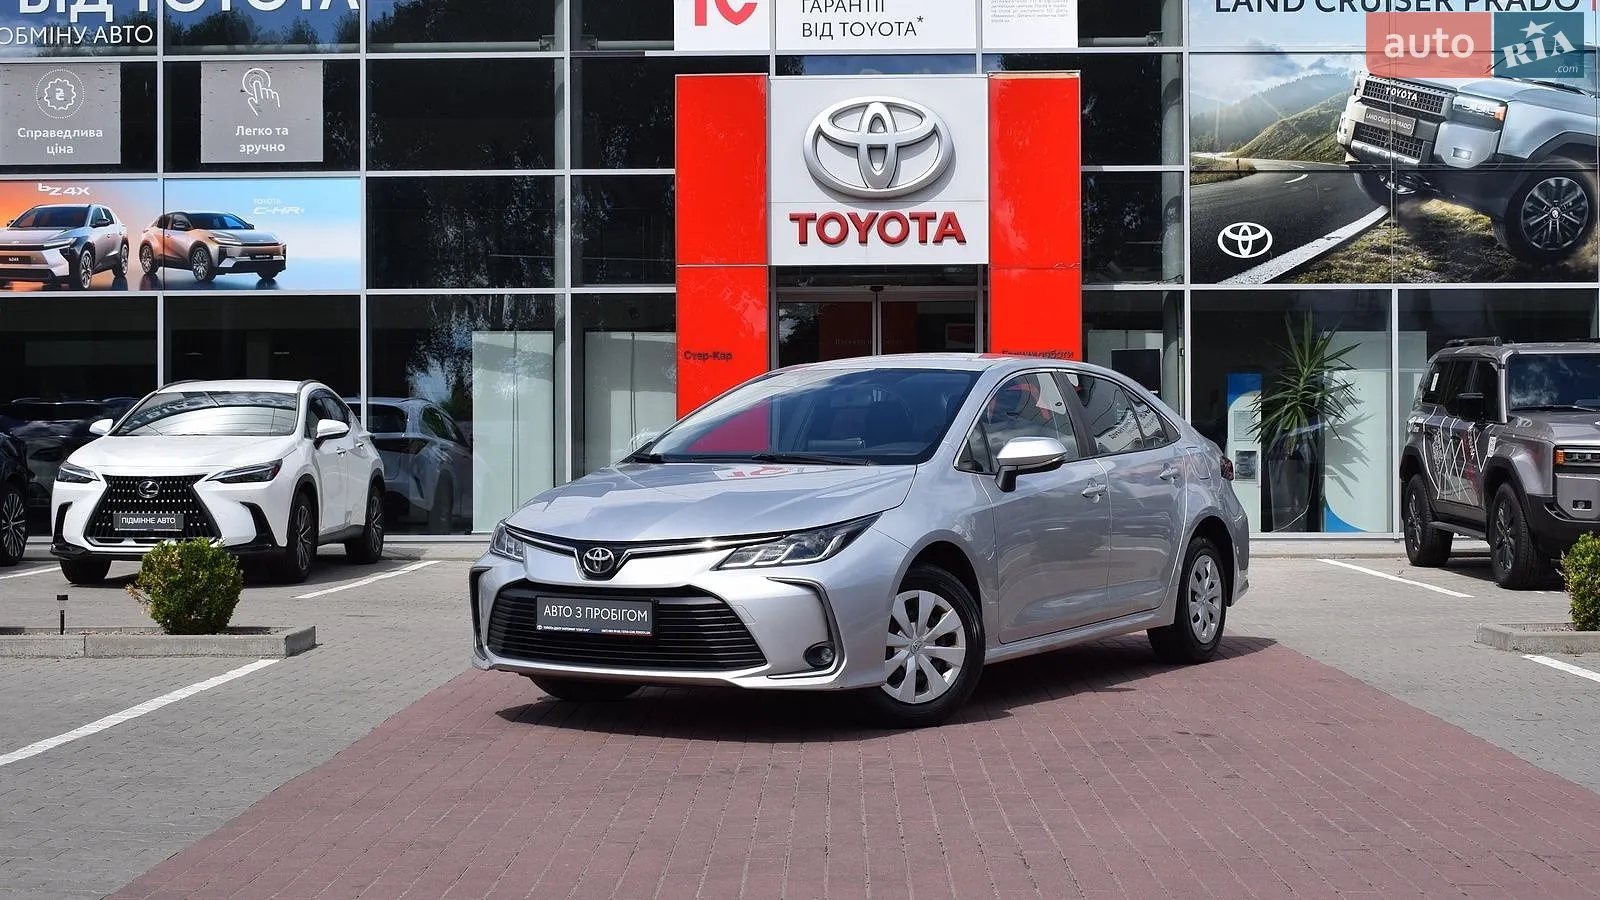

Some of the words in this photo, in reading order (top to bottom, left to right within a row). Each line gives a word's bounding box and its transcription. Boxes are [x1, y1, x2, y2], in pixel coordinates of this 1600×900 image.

[93, 25, 154, 44] АВТО
[802, 22, 834, 41] ВІД
[1386, 87, 1418, 101] TOYOTA
[17, 127, 103, 141] Справедлива
[235, 125, 271, 137] Легко
[273, 126, 289, 136] та
[46, 142, 74, 155] ціна
[239, 142, 286, 154] зручно
[38, 183, 90, 196] bZ4X
[789, 211, 967, 246] TOYOTA
[121, 517, 156, 525] ПІДМІННЕ
[543, 604, 573, 618] АВТО
[585, 607, 648, 622] ПРОБІГОМ
